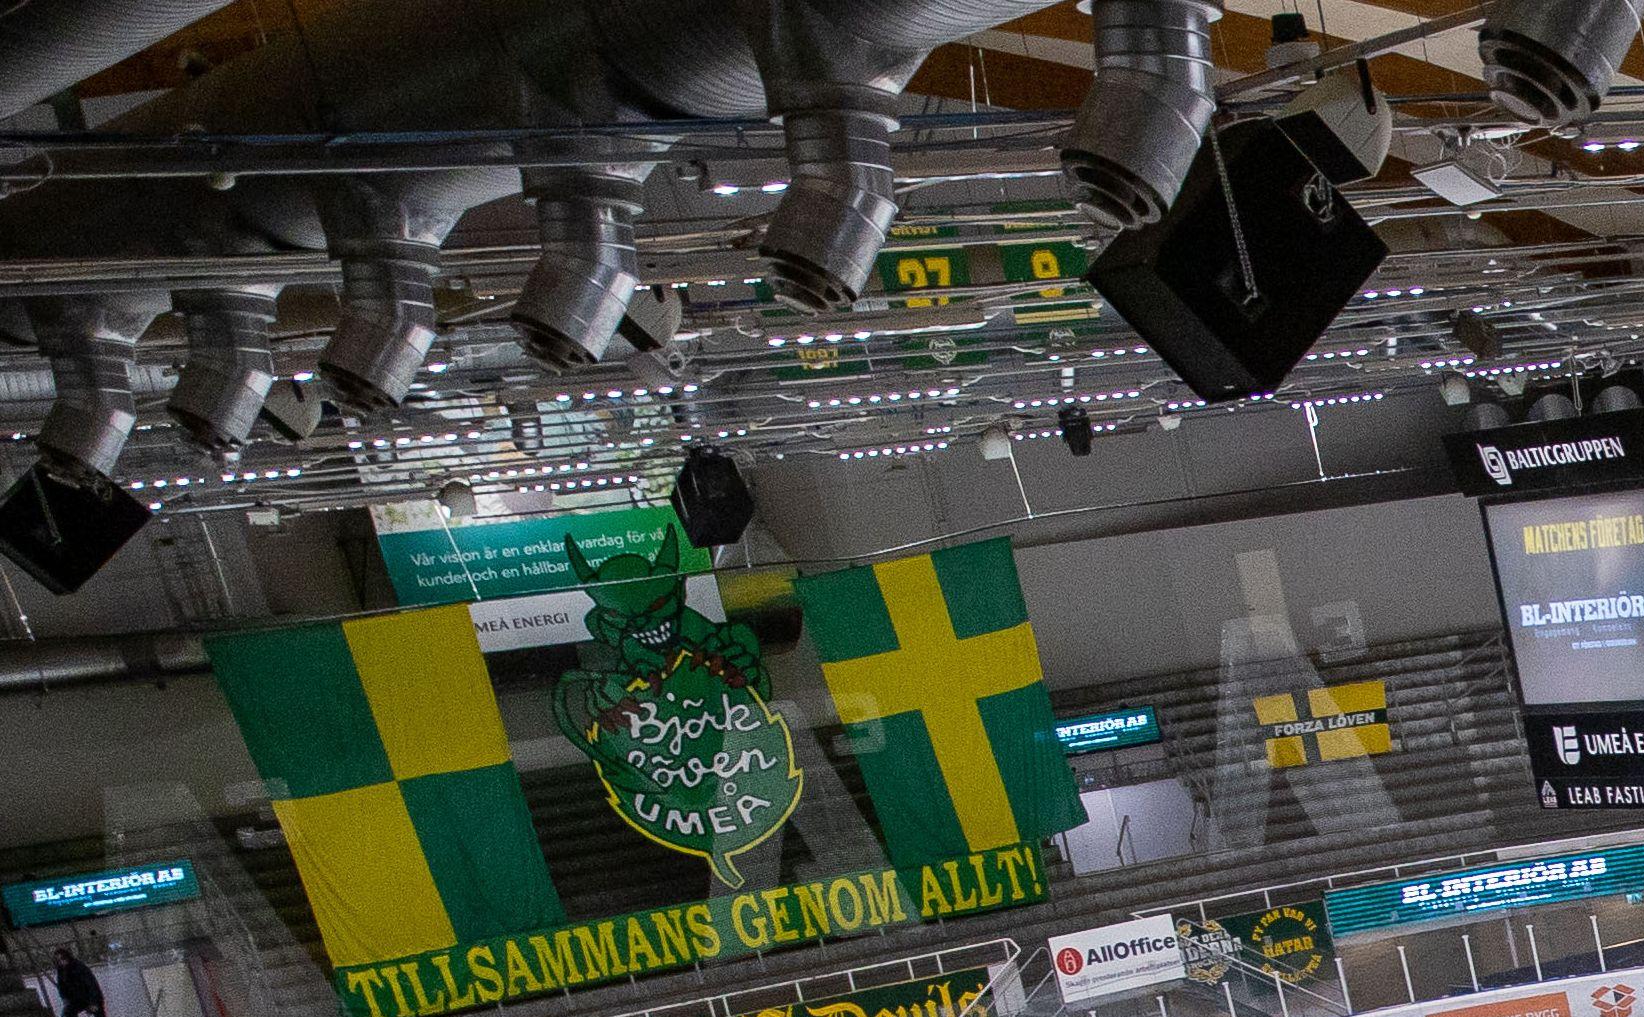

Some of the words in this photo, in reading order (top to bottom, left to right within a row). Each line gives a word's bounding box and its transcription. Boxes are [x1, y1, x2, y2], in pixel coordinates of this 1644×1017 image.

[1506, 437, 1625, 470] BALTICGRUPPEN
[1523, 518, 1589, 555] MATCHENS
[1590, 514, 1644, 546] FÖRETAG
[411, 551, 436, 568] Vår
[448, 548, 480, 566] vison
[503, 545, 520, 558] en
[501, 566, 520, 580] en
[523, 556, 570, 578] hållbar
[474, 613, 509, 634] MEÅ
[513, 611, 571, 631] ENERGI
[1520, 590, 1644, 628] BL-INTERIÖR
[1274, 719, 1326, 738] FORZA
[1326, 710, 1376, 730] LÖVEN
[1584, 727, 1635, 755] UMEÅ
[633, 780, 774, 838] UMEÅ
[1569, 786, 1602, 805] LEAB
[731, 870, 906, 946] GENOM
[918, 847, 1044, 921] ALLT!
[1085, 933, 1177, 968] AllOffice
